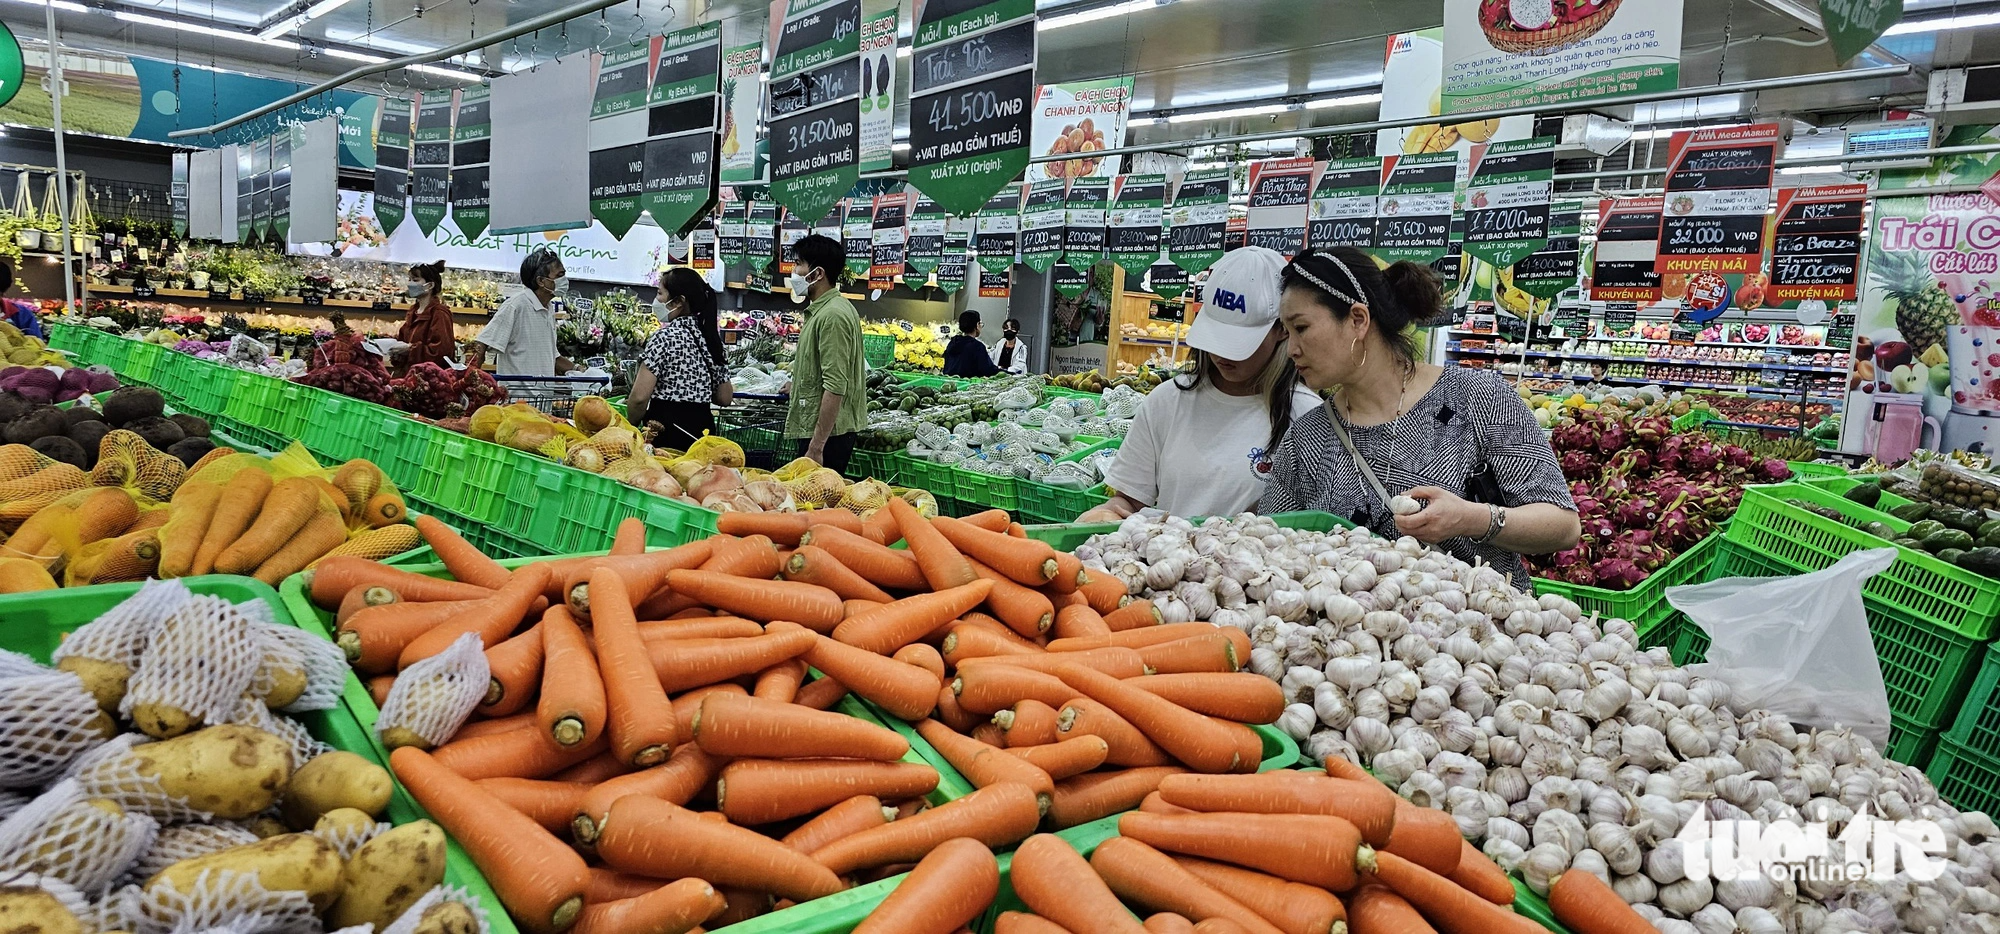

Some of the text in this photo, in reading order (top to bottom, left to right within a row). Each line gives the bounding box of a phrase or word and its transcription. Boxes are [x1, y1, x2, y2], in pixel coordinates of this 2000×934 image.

[948, 25, 958, 37] Kg
[960, 16, 982, 34] (Each
[984, 11, 1000, 25] kg):
[1622, 32, 1632, 40] da
[1606, 46, 1622, 55] hay
[796, 58, 804, 70] Kg
[805, 52, 822, 67] (Each
[1525, 69, 1547, 78] Thanh
[1549, 66, 1568, 76] Long
[928, 91, 1022, 132] 41.500 VNĐ
[1044, 106, 1076, 118] CHANH
[788, 118, 836, 153] 31.500
[834, 122, 852, 140] VNĐ
[916, 146, 938, 161] +VAT
[940, 140, 964, 159] (BAO
[990, 124, 1022, 146] THUẾ)
[692, 151, 706, 164] VNĐ
[775, 162, 792, 176] +VAT
[792, 158, 810, 174] (BAO
[970, 158, 1002, 175] (Origin):
[1525, 216, 1544, 225] VNĐ
[434, 224, 504, 250] Daat
[1171, 226, 1212, 246] 28.000
[1312, 222, 1360, 240] 20.000
[1384, 221, 1446, 237] 25.600 VNĐ
[1486, 232, 1502, 240] (BAO
[1670, 227, 1758, 244] 22.000 VNĐ
[1880, 214, 1960, 251] Trái
[1024, 230, 1049, 246] 17.000
[1493, 250, 1512, 264] TG
[1667, 255, 1718, 270] KHUYẾN
[1722, 257, 1747, 270] MÃI
[582, 265, 596, 275] life
[1598, 288, 1652, 298] KHUYẾN MÃI
[1778, 286, 1844, 298] KHUYẾN MÃI
[1212, 288, 1246, 314] NBA
